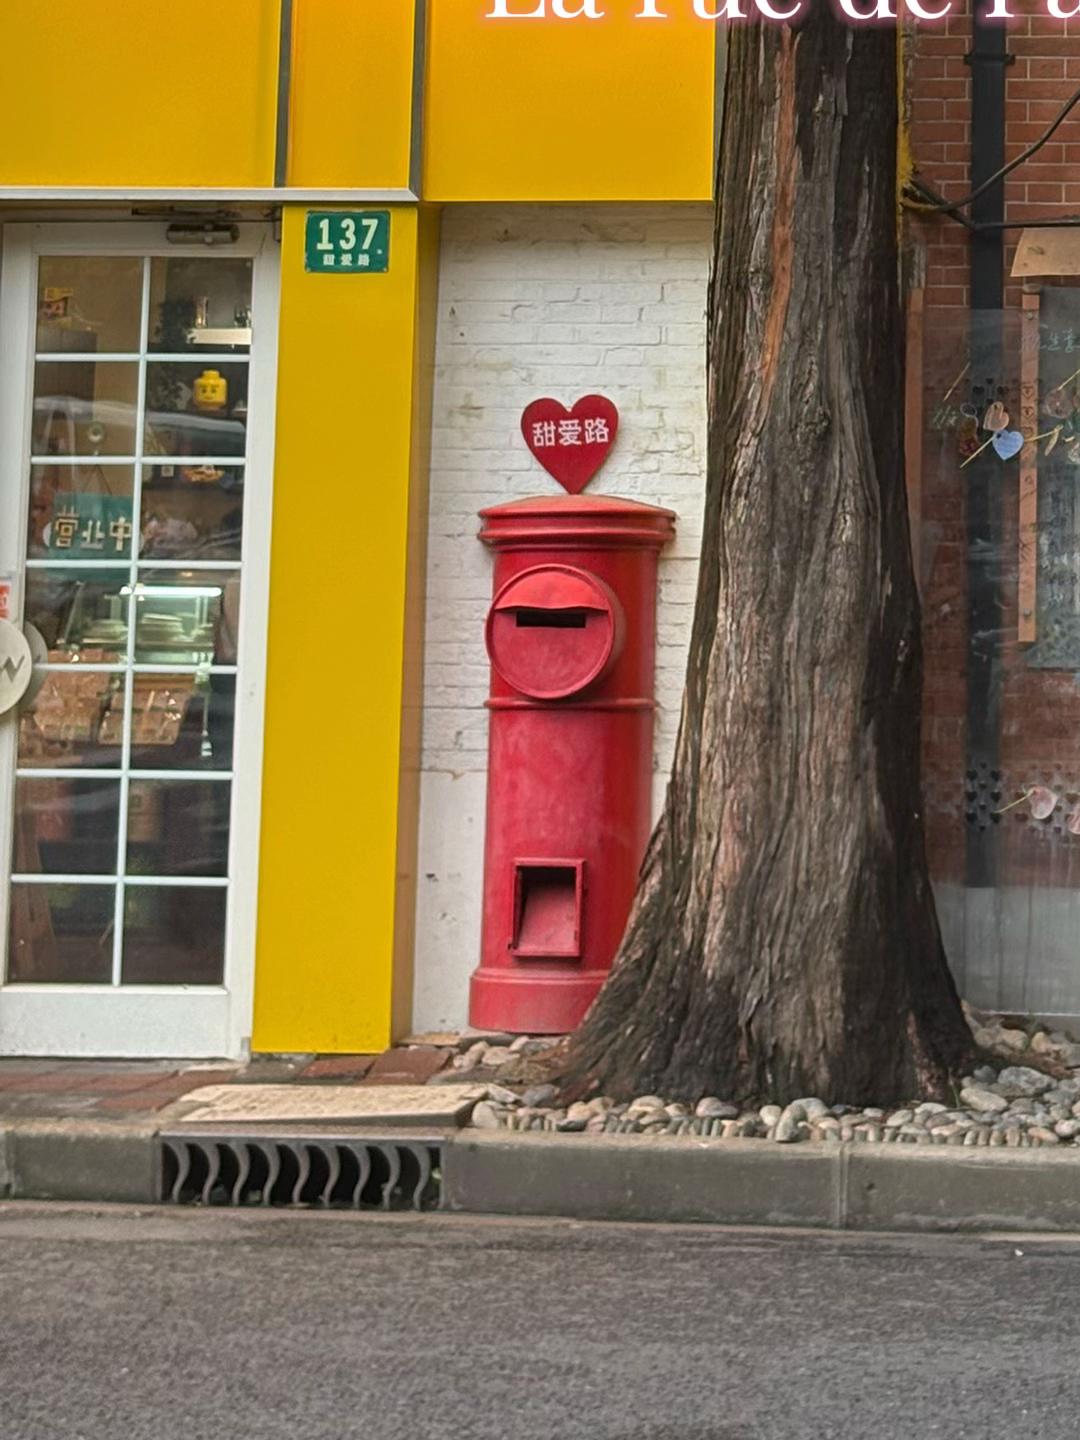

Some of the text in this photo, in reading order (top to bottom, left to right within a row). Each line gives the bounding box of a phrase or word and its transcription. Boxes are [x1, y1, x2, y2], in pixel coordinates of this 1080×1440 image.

[316, 218, 379, 250] 137
[532, 418, 610, 447] 甜爱路
[55, 505, 132, 552] 营业中
